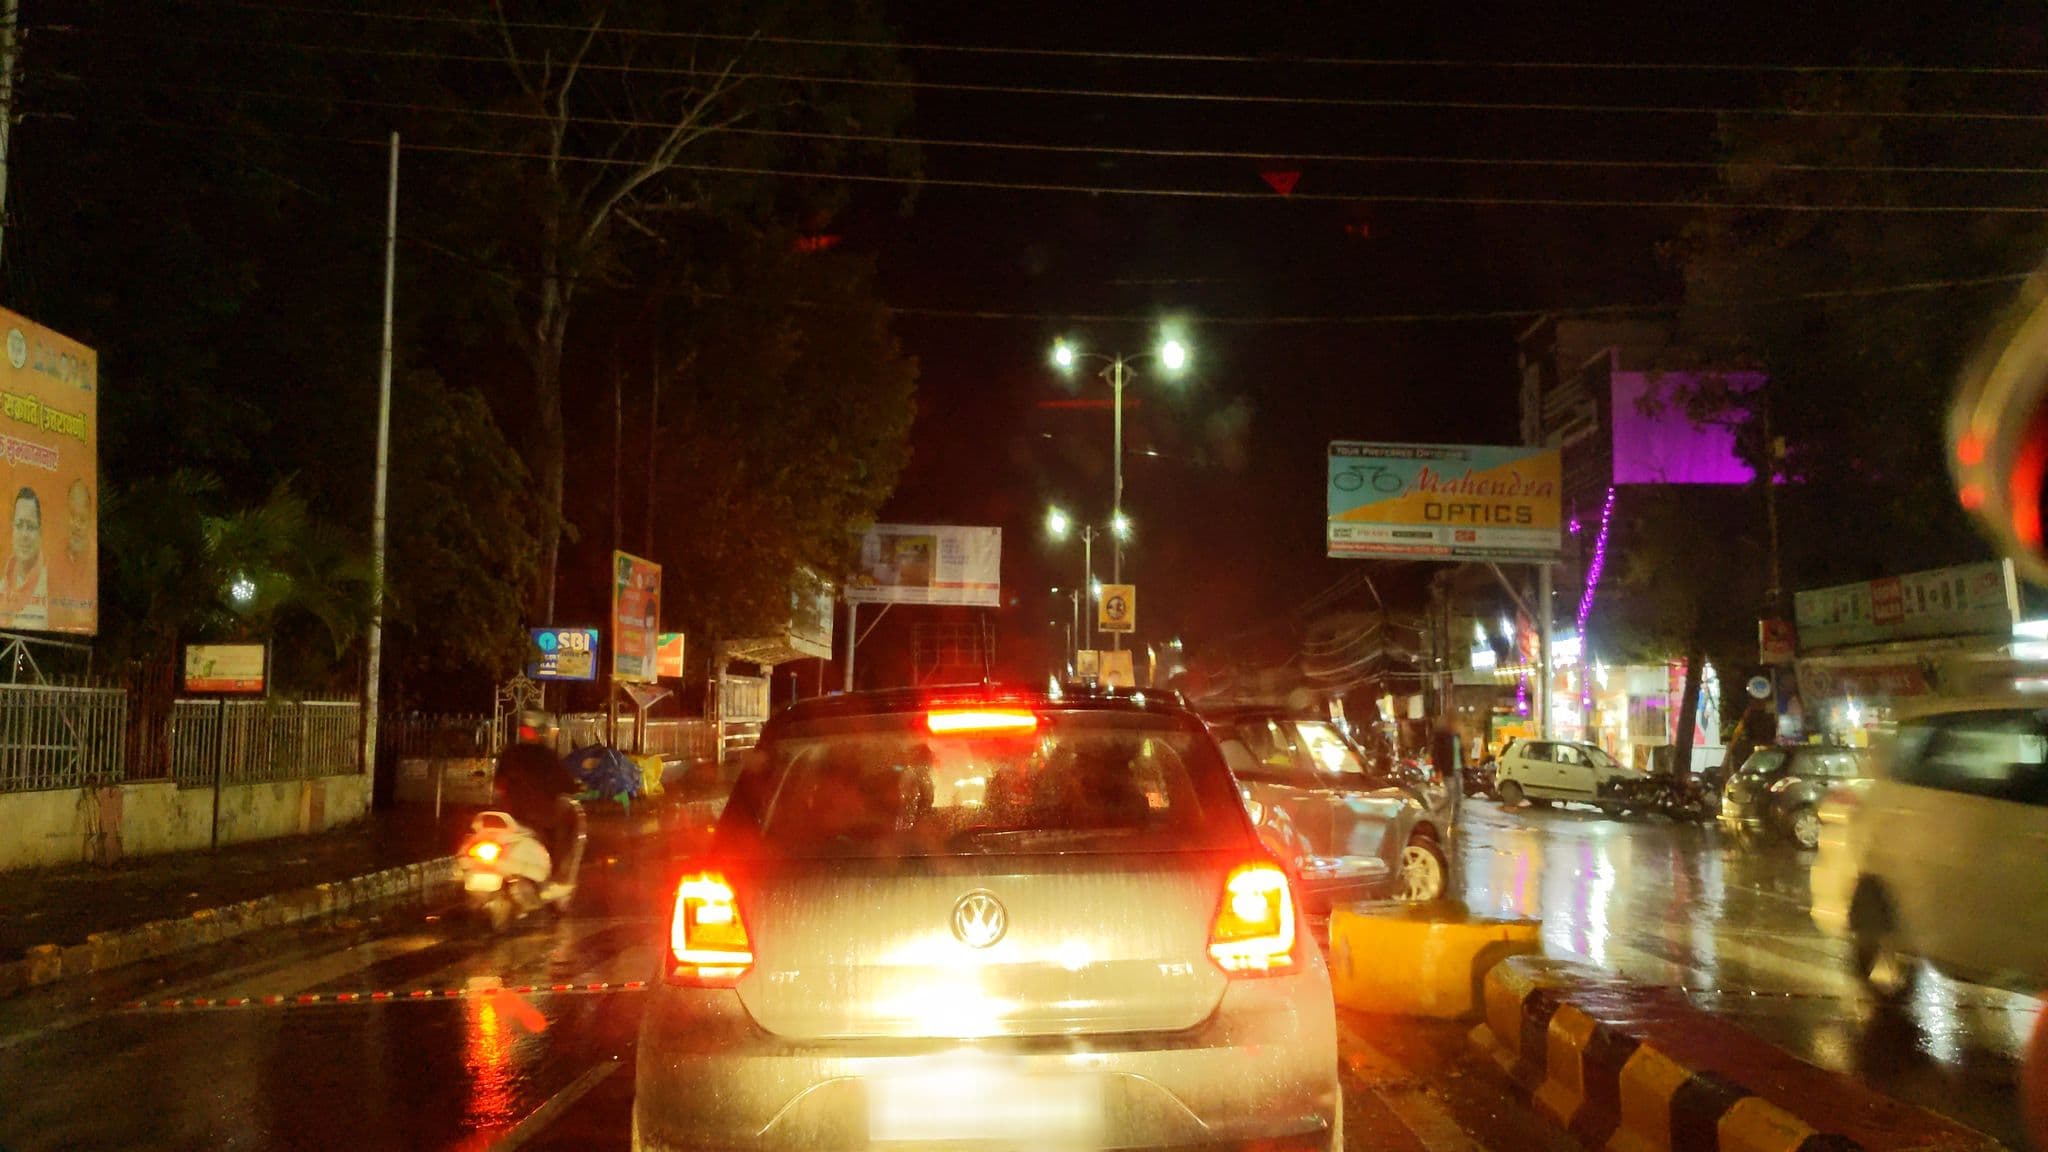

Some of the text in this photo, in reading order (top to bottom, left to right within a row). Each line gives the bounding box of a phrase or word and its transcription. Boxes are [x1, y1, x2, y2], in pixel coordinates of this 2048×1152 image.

[1402, 464, 1553, 499] Mahendra
[1424, 502, 1532, 524] OPTICS
[557, 631, 590, 651] SBI
